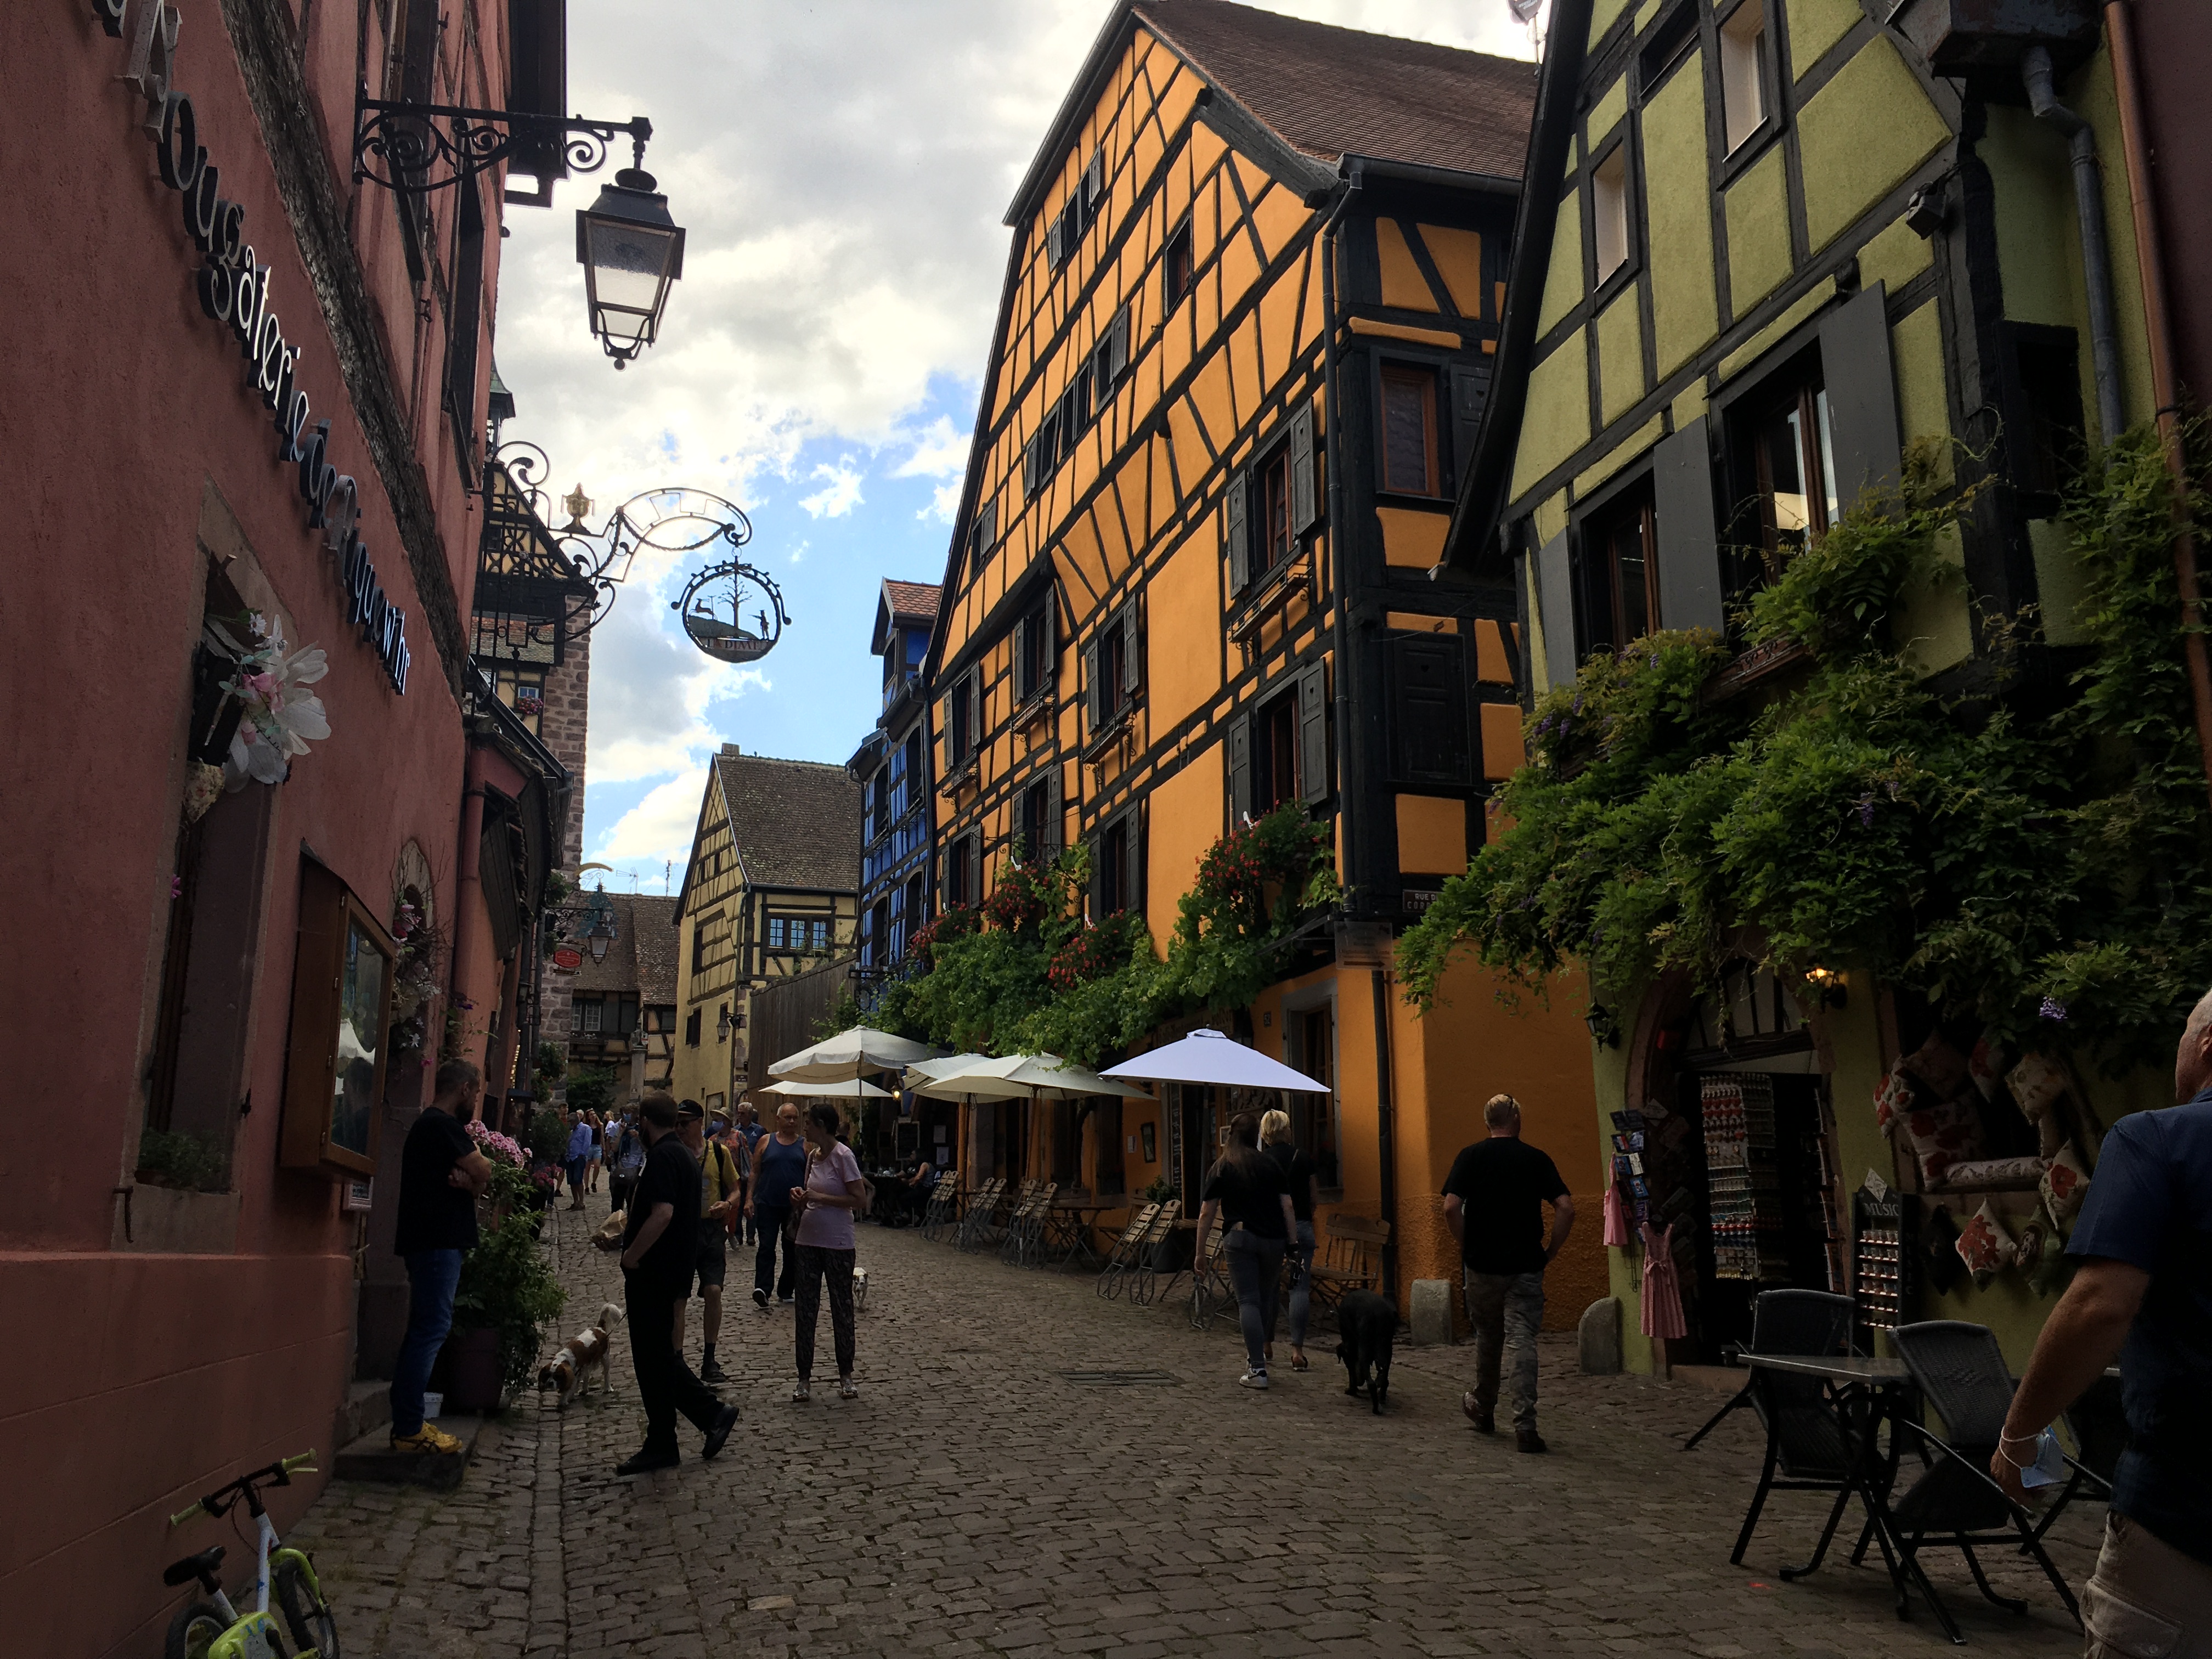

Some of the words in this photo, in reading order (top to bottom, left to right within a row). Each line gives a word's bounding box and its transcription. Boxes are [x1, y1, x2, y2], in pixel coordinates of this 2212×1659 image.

[301, 418, 338, 529] de
[1864, 1203, 1899, 1216] MUSIC
[1905, 1232, 1914, 1295] MUSIC
